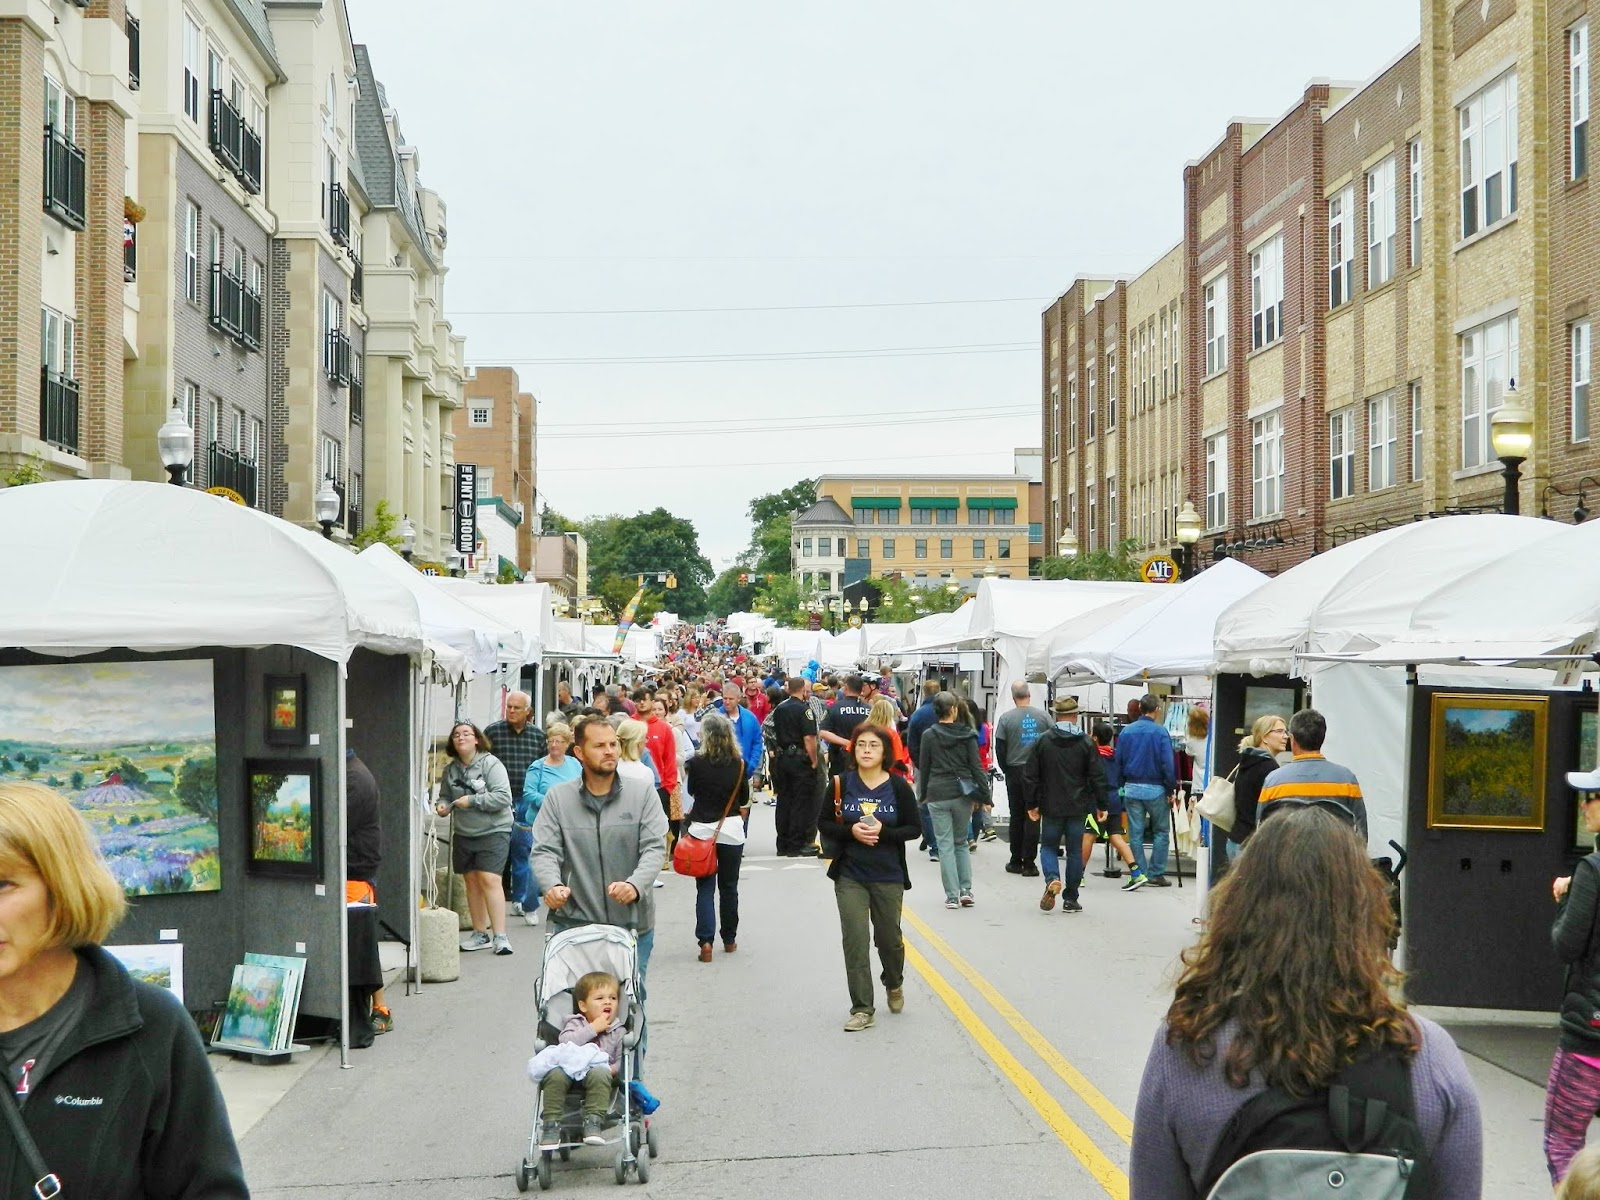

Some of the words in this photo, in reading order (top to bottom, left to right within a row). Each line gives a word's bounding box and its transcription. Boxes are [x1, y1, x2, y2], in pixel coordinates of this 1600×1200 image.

[461, 465, 473, 473] THE
[461, 474, 473, 500] PINT
[461, 518, 473, 552] ROOM
[840, 706, 871, 716] POLICE
[64, 1095, 103, 1106] Columbia
